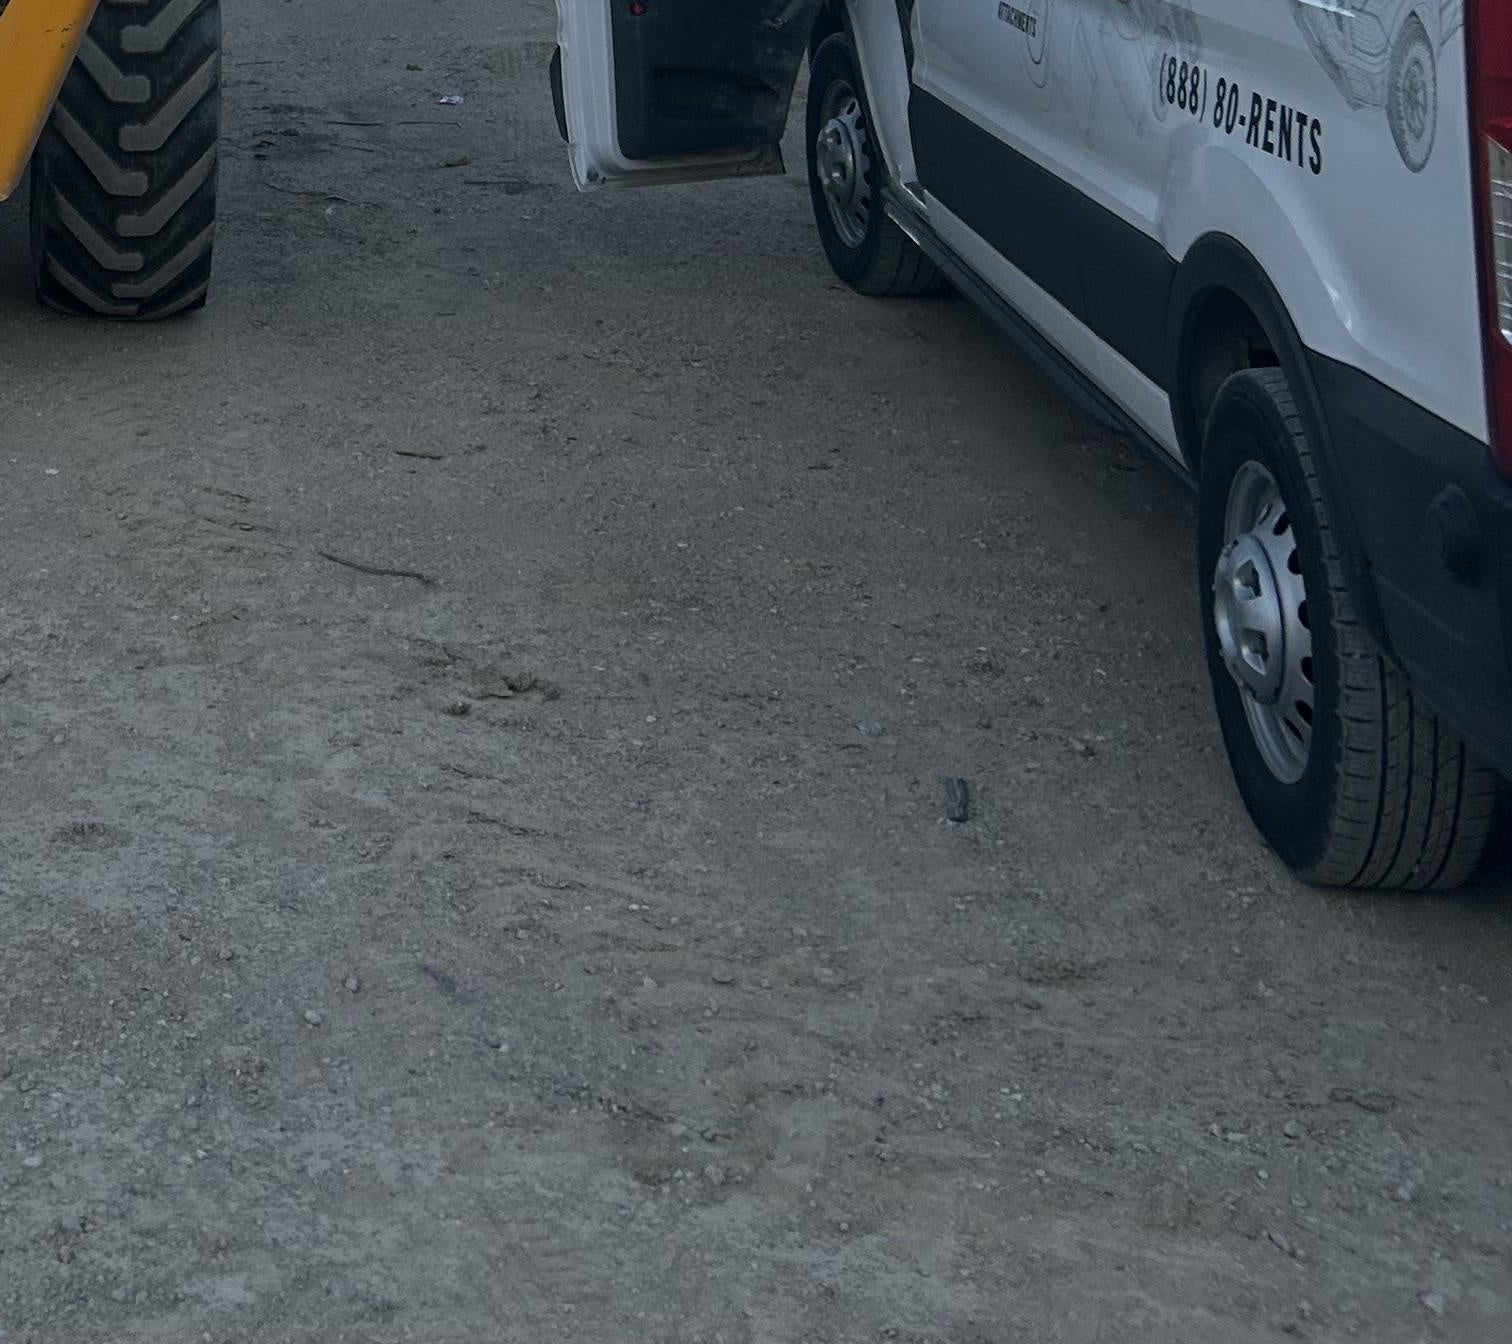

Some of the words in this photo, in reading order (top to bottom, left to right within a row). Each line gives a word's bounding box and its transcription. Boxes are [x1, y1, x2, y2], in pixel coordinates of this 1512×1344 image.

[998, 0, 1037, 38] ATTACHMENTS
[1160, 52, 1208, 123] (888)
[1213, 77, 1322, 175] 80-RENTS
